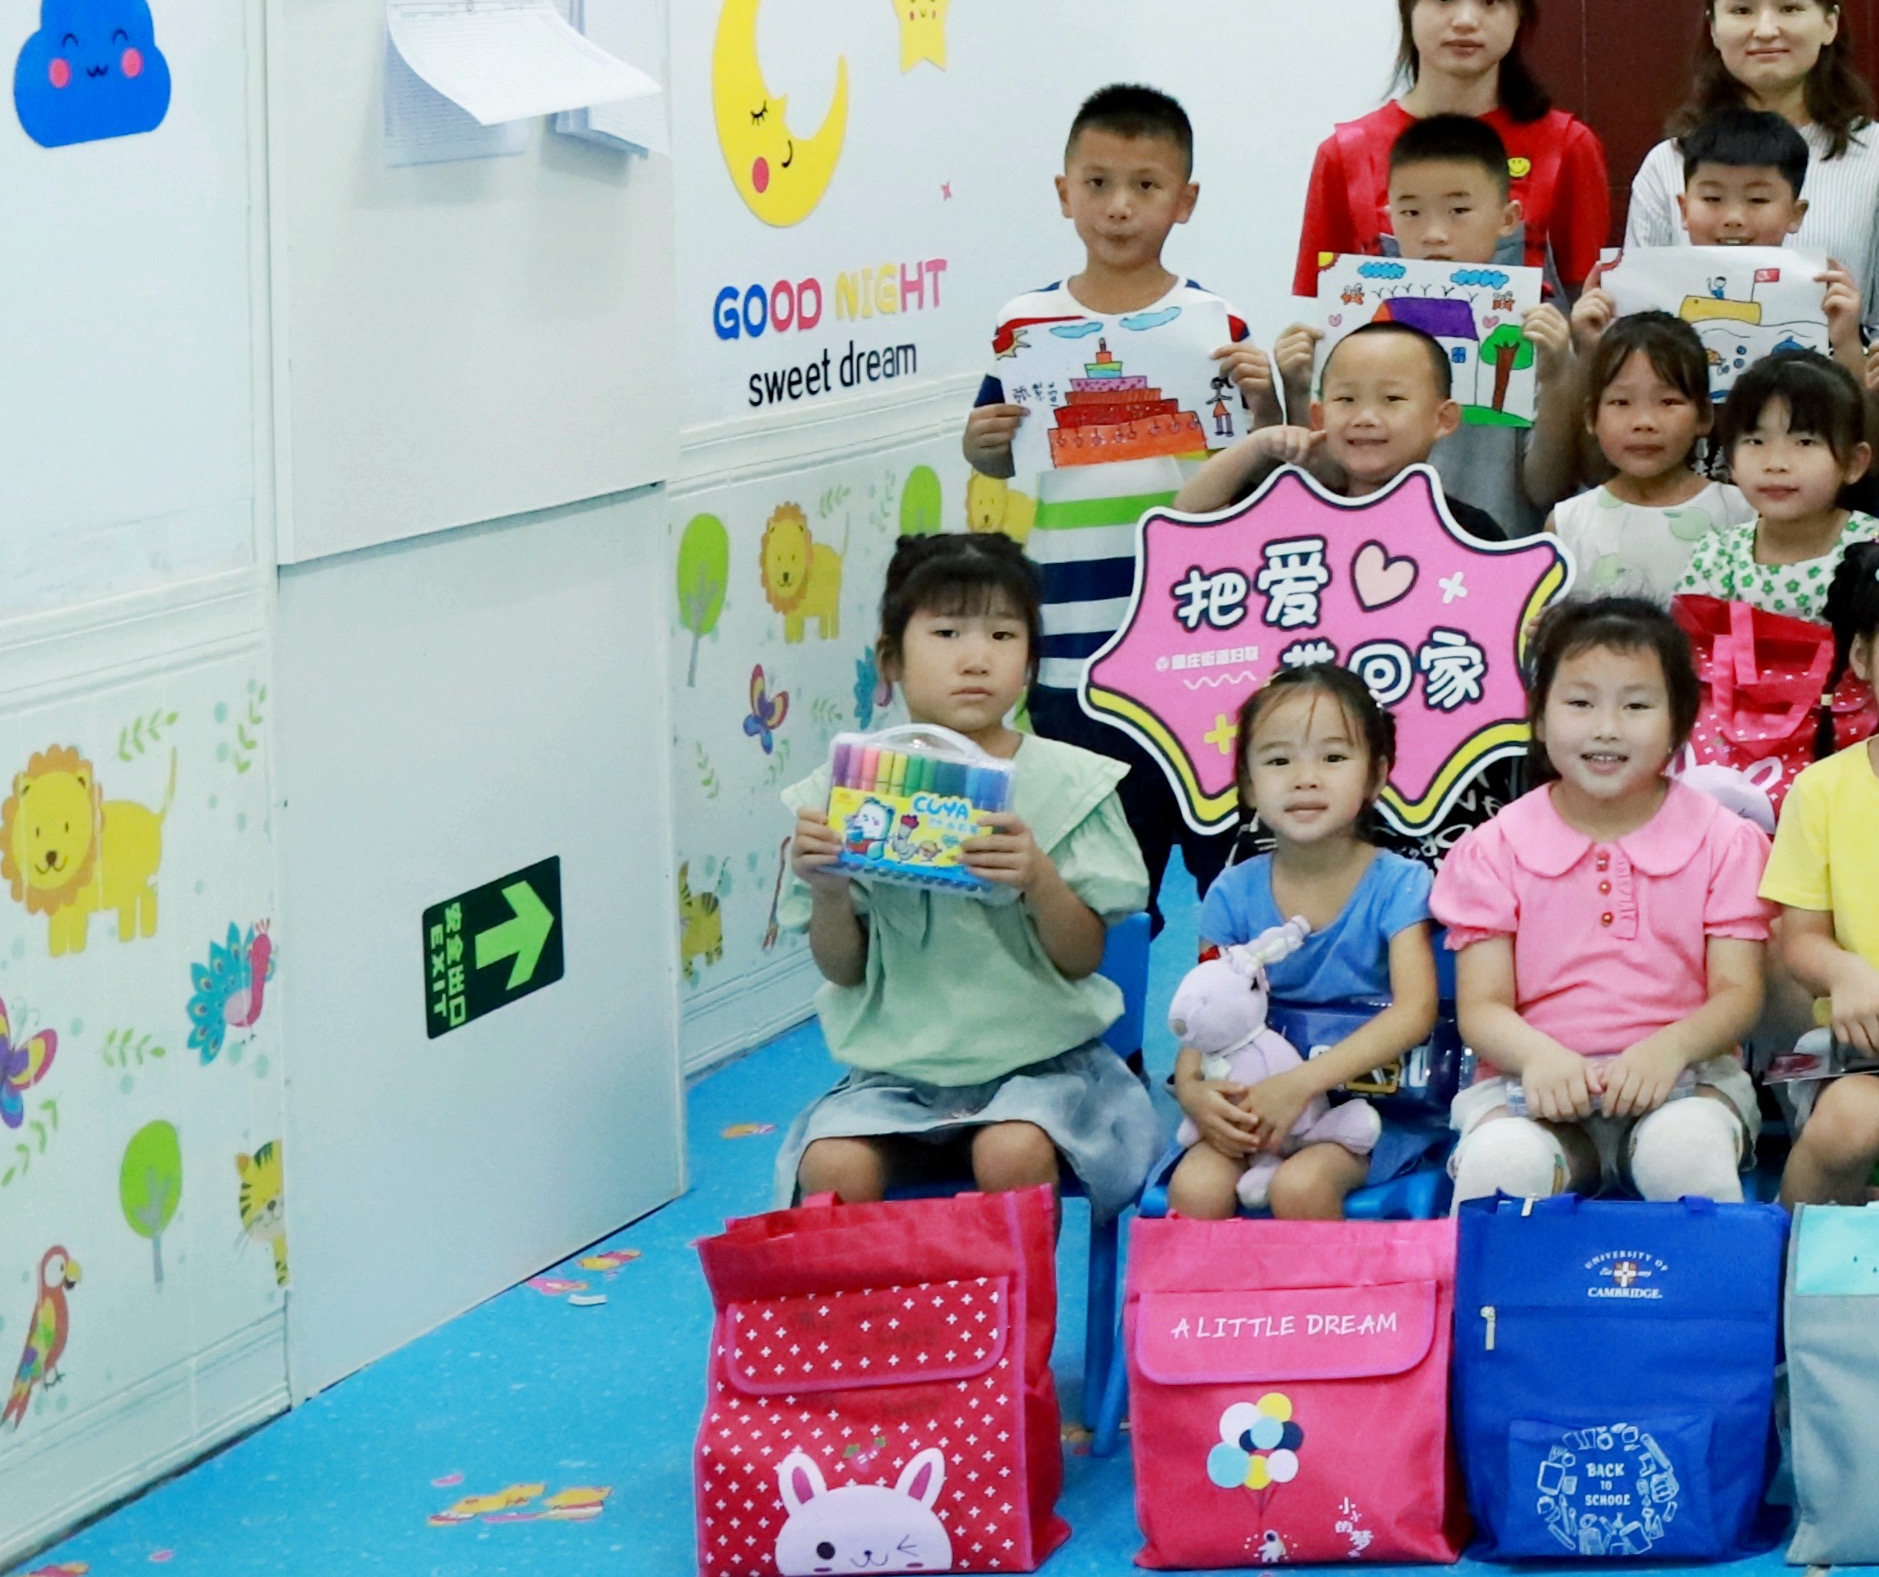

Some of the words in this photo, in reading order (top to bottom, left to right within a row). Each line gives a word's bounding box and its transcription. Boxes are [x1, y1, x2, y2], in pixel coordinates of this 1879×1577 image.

[713, 278, 822, 341] GOOD
[835, 258, 949, 321] NIGHT
[748, 348, 832, 407] sweet
[840, 340, 918, 388] dream
[1173, 538, 1331, 629] 把爱
[429, 923, 447, 1018] EXIT
[444, 901, 467, 1028] 安全出口
[1171, 1318, 1190, 1339] A
[1197, 1315, 1297, 1338] LITTLE
[1306, 1312, 1398, 1336] DREAM
[1584, 1494, 1632, 1507] SCHOOL
[1585, 1462, 1626, 1478] BACK
[1600, 1480, 1613, 1492] TO
